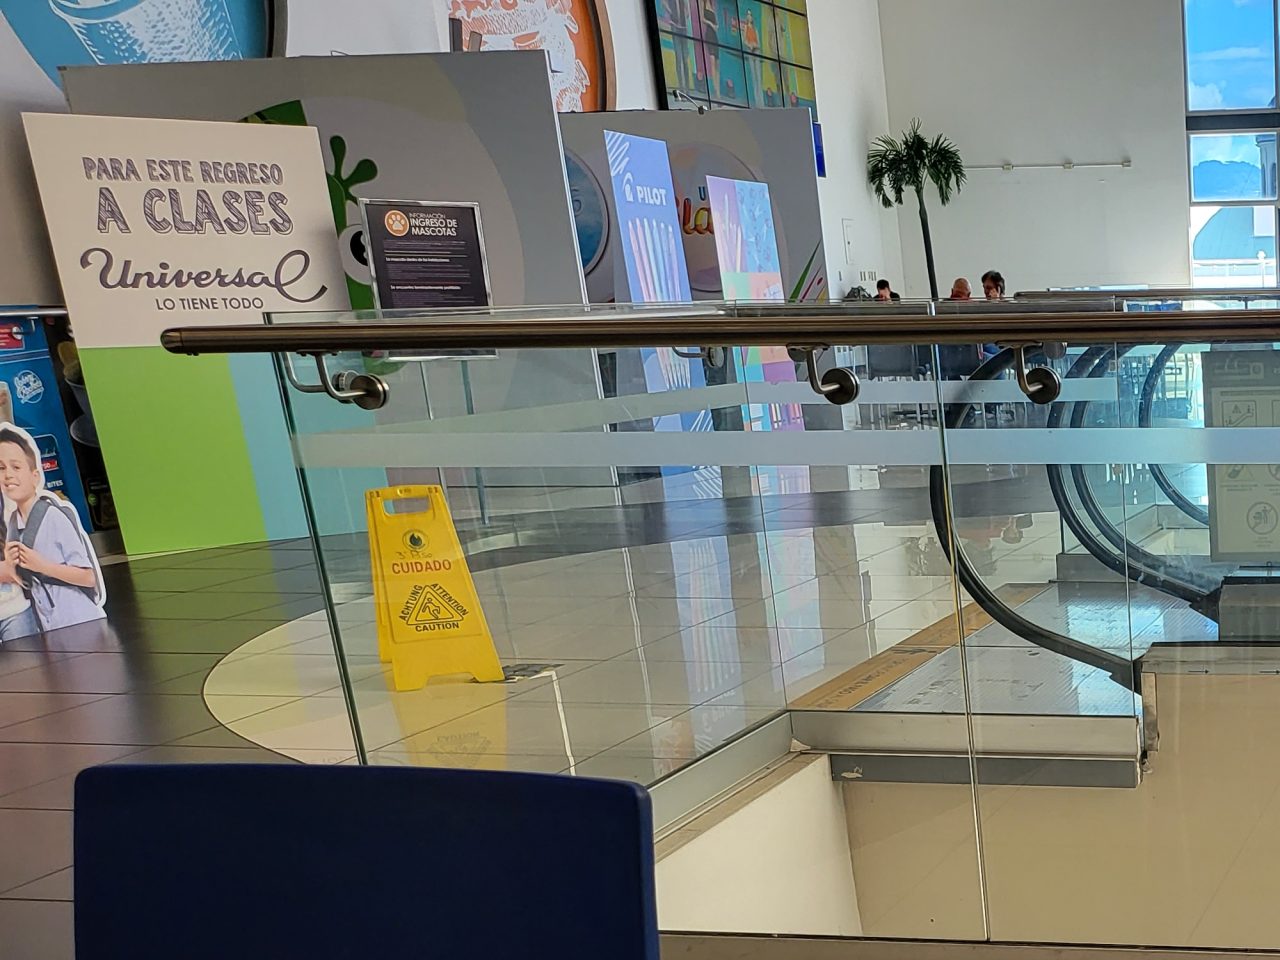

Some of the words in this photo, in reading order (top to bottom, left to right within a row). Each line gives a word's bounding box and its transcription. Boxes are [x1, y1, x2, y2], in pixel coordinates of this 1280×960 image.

[82, 157, 142, 182] PARA
[146, 159, 194, 184] ESTE
[199, 160, 284, 186] REGRESO
[636, 185, 667, 206] PILOT
[97, 187, 132, 234] A
[143, 188, 294, 236] CLASES
[410, 218, 446, 227] INGRESO
[446, 219, 458, 228] DE
[412, 227, 457, 236] MASCOTAS
[80, 247, 329, 304] Universal
[156, 297, 176, 311] LO
[179, 297, 219, 311] TIENE
[223, 297, 264, 311] TODO
[391, 559, 452, 575] CUIDADO
[398, 584, 423, 621] ACHTUNG
[430, 583, 469, 616] ATTENTION
[415, 622, 460, 632] CAUTION
